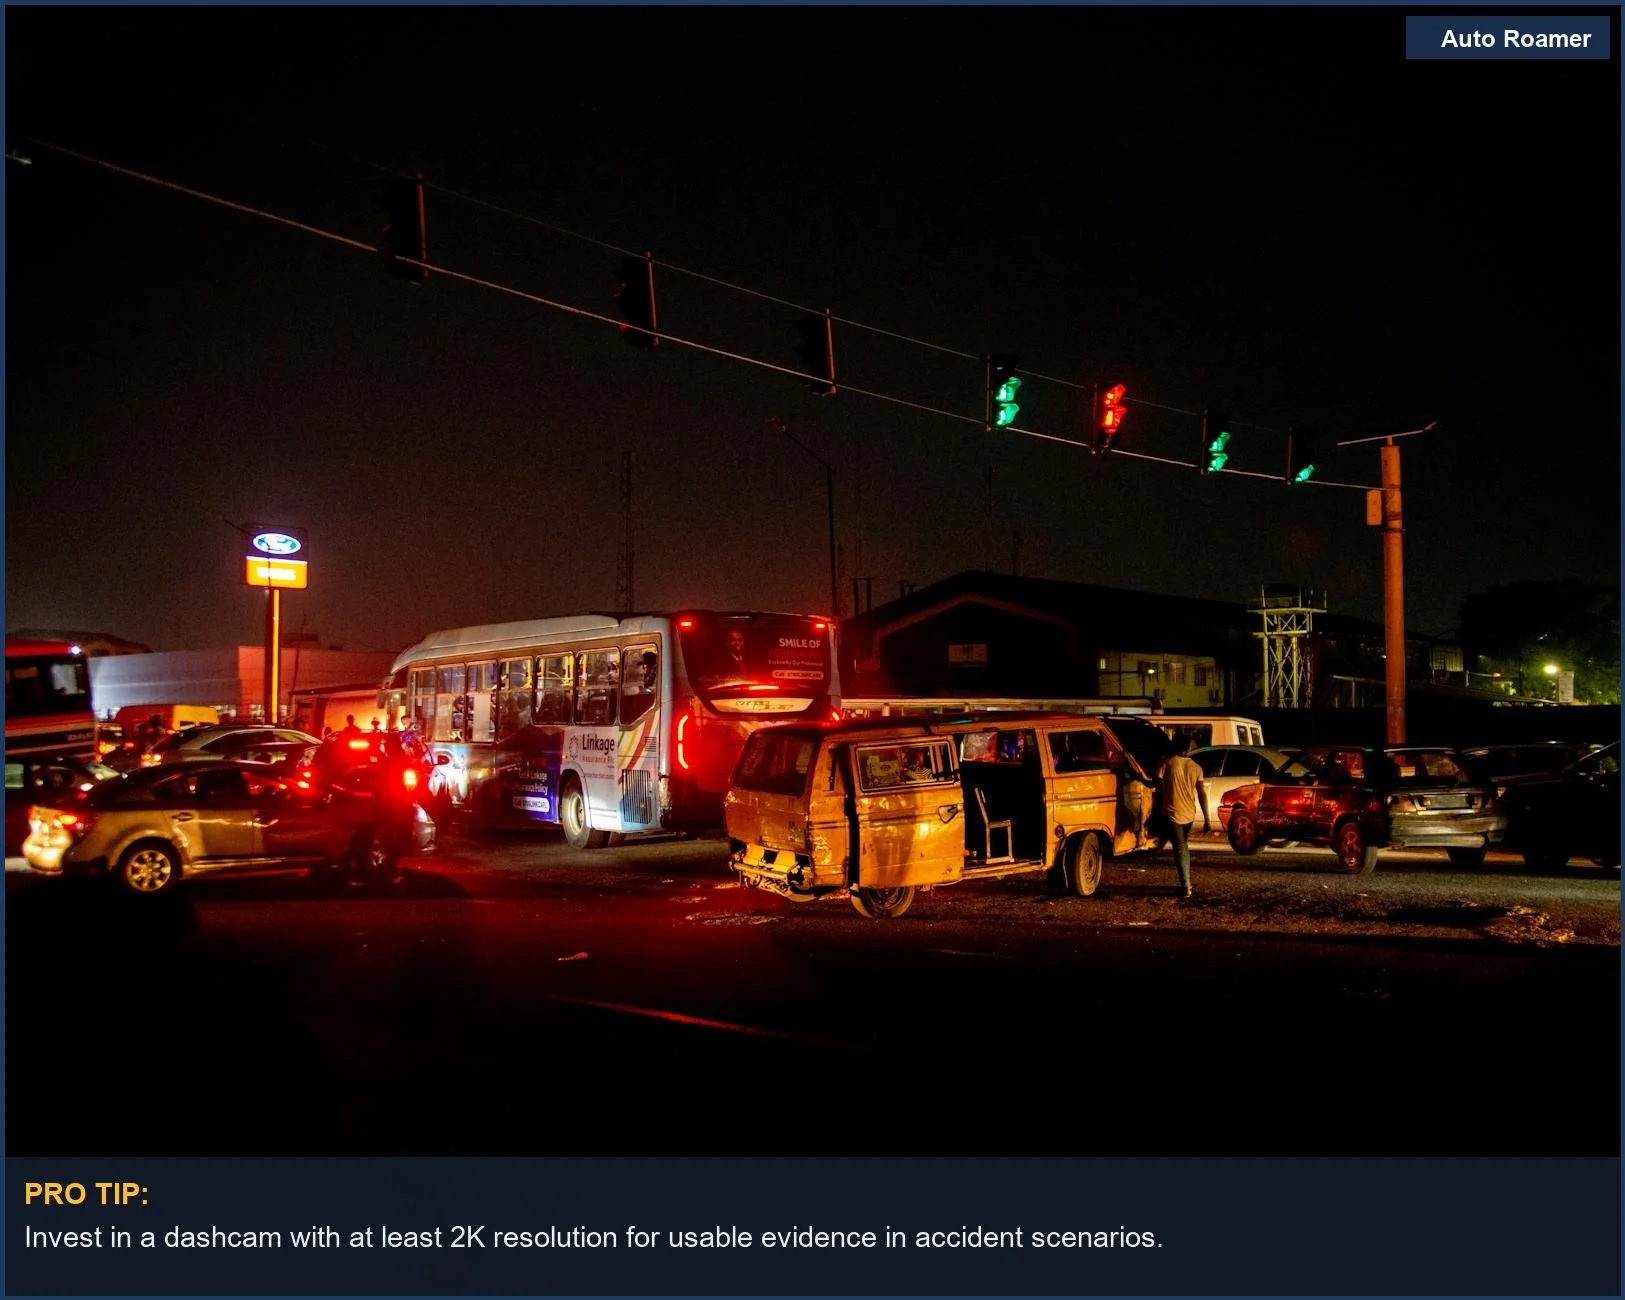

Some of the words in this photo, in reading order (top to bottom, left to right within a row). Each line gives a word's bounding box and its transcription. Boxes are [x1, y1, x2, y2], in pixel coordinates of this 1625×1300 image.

[779, 638, 808, 649] SMILE
[808, 639, 821, 649] OF
[582, 734, 615, 755] Linkage
